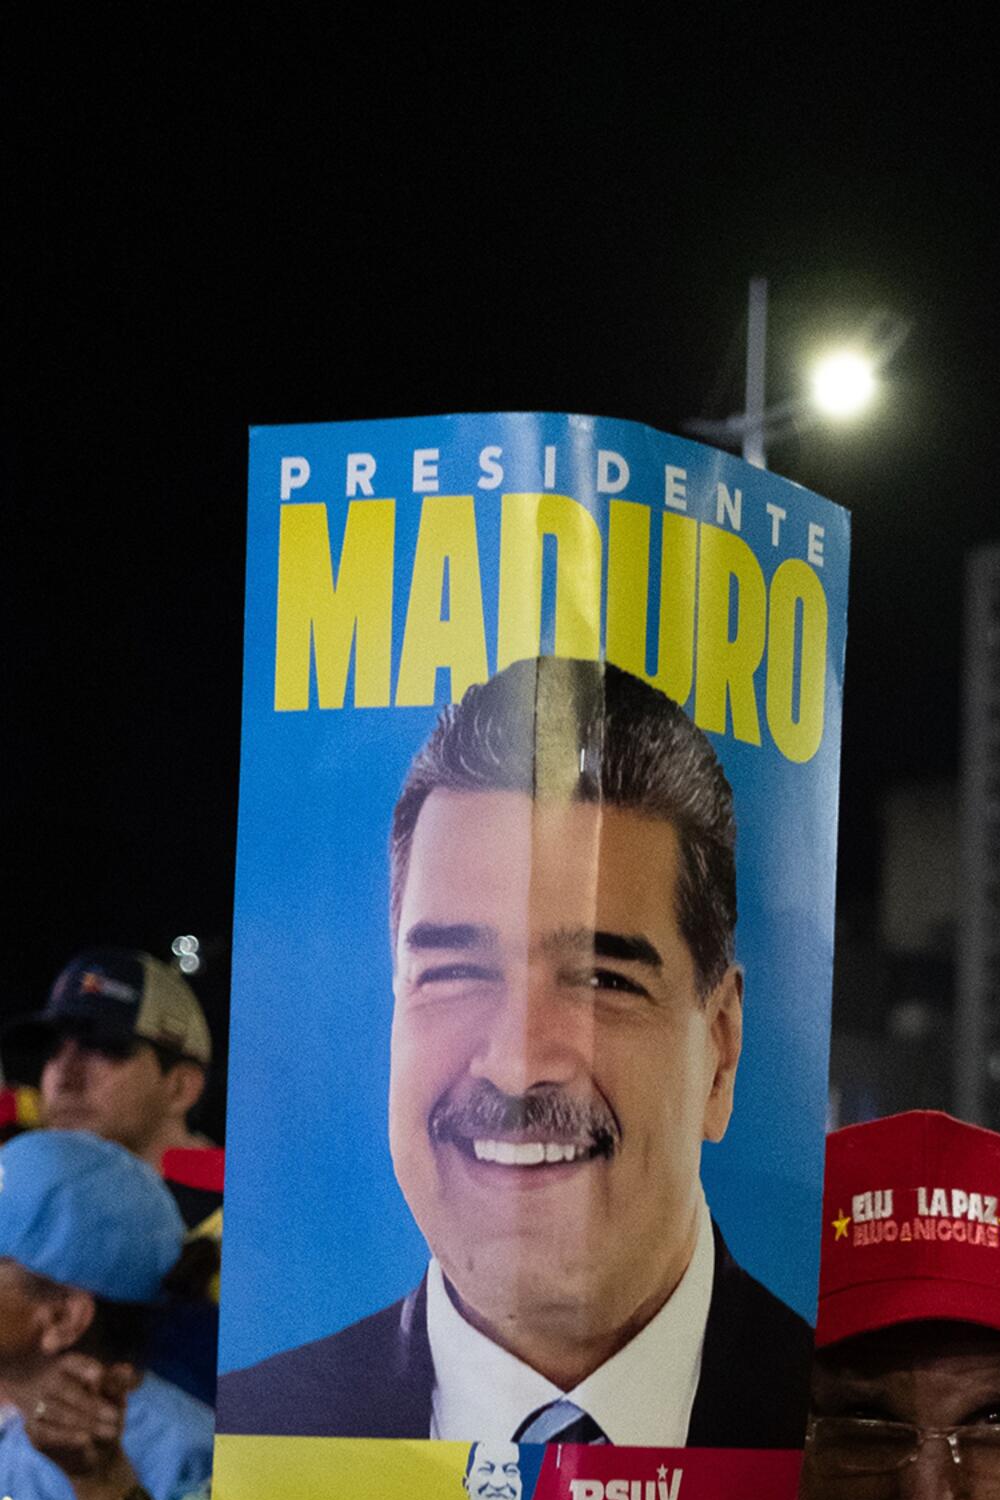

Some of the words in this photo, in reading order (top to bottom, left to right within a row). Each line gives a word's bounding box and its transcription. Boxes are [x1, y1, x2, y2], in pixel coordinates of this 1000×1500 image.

[280, 445, 825, 567] PRESIDENTE
[273, 492, 828, 764] MADURO
[913, 1217, 999, 1249] NICOLAS
[951, 1187, 999, 1226] PAZ
